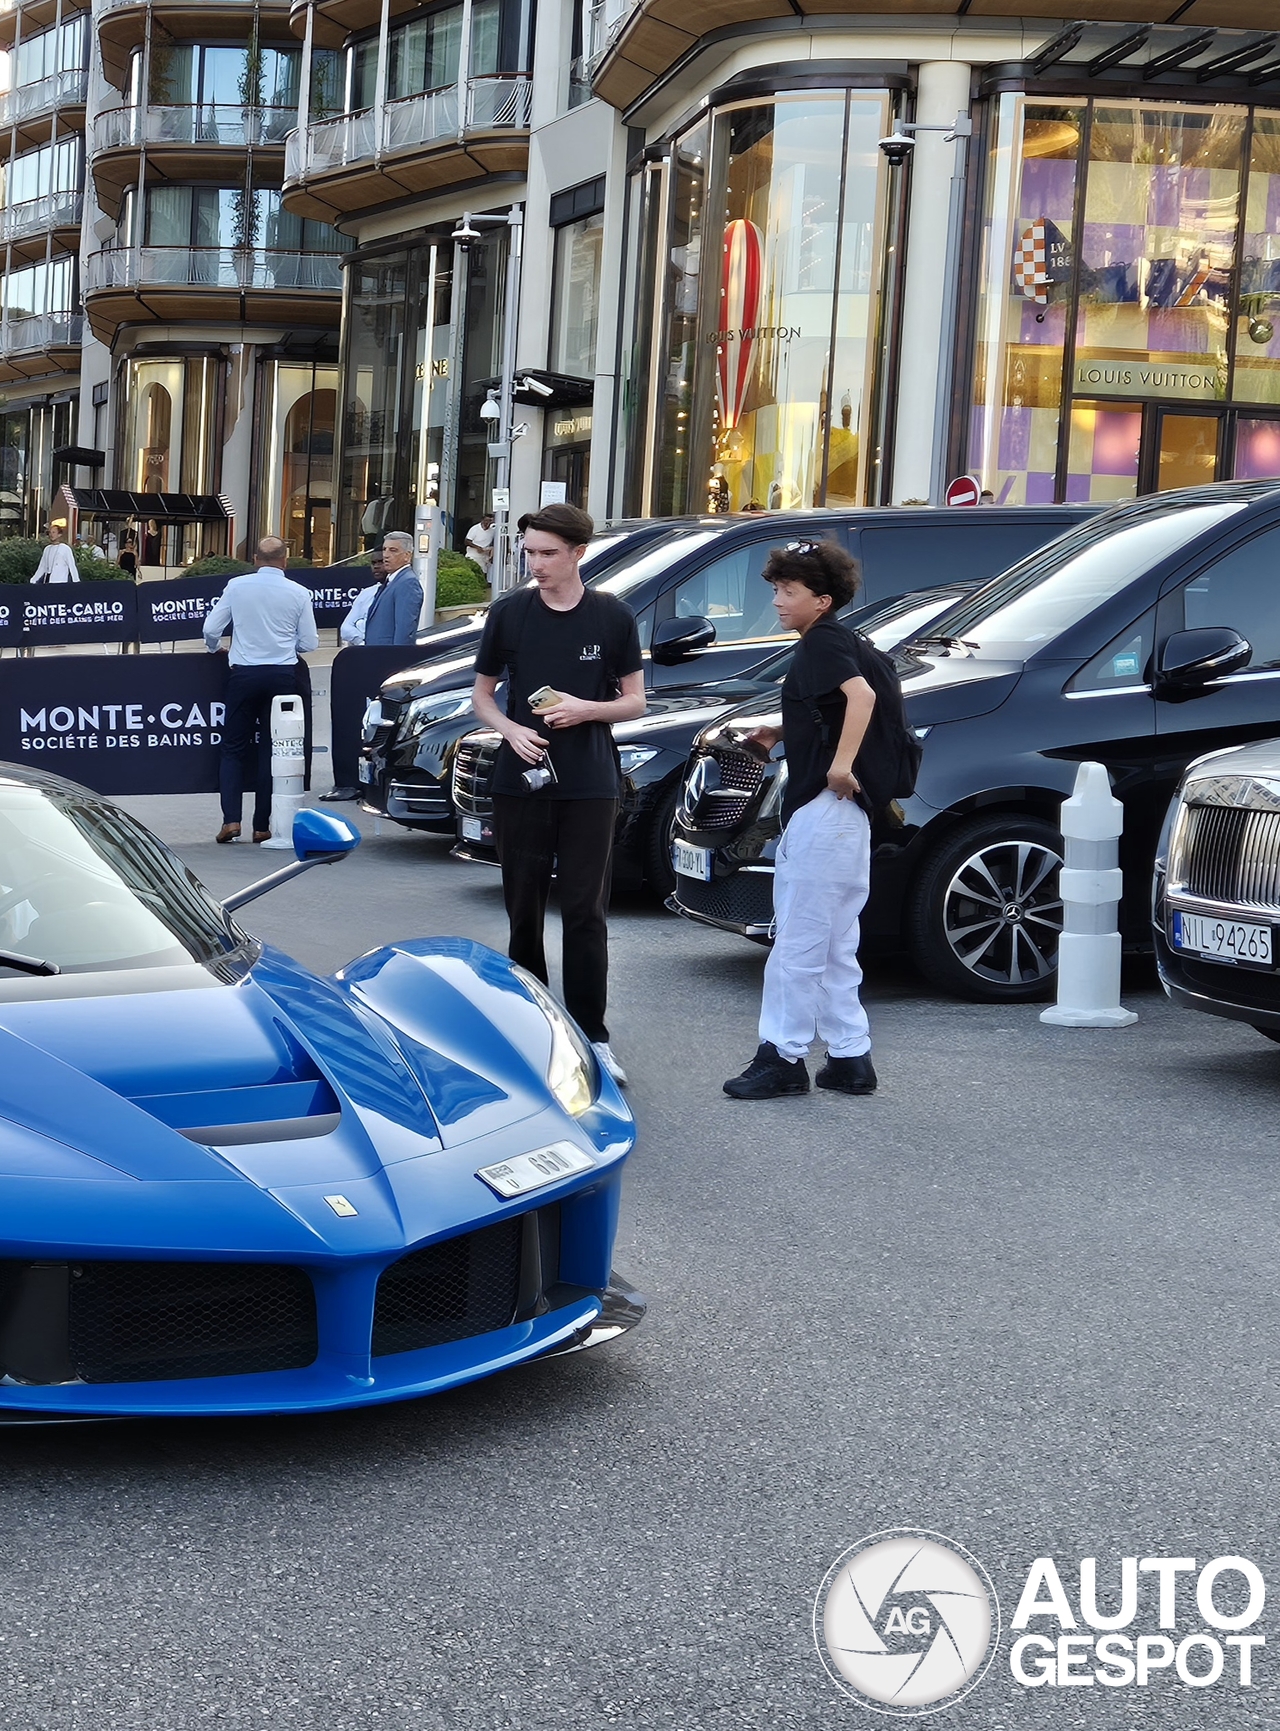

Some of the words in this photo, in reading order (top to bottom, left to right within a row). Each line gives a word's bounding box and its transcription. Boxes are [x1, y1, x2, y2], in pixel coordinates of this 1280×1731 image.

[1050, 242, 1066, 254] LV
[739, 326, 802, 341] VUITTON
[1078, 367, 1132, 385] LOUIS
[1140, 369, 1215, 390] VUITTON
[21, 732, 98, 750] SOCIÉTÉ
[106, 735, 140, 749] DES
[147, 732, 203, 747] BAINS
[210, 732, 222, 745] D
[1182, 916, 1210, 949] NIL
[1215, 923, 1269, 959] 94265
